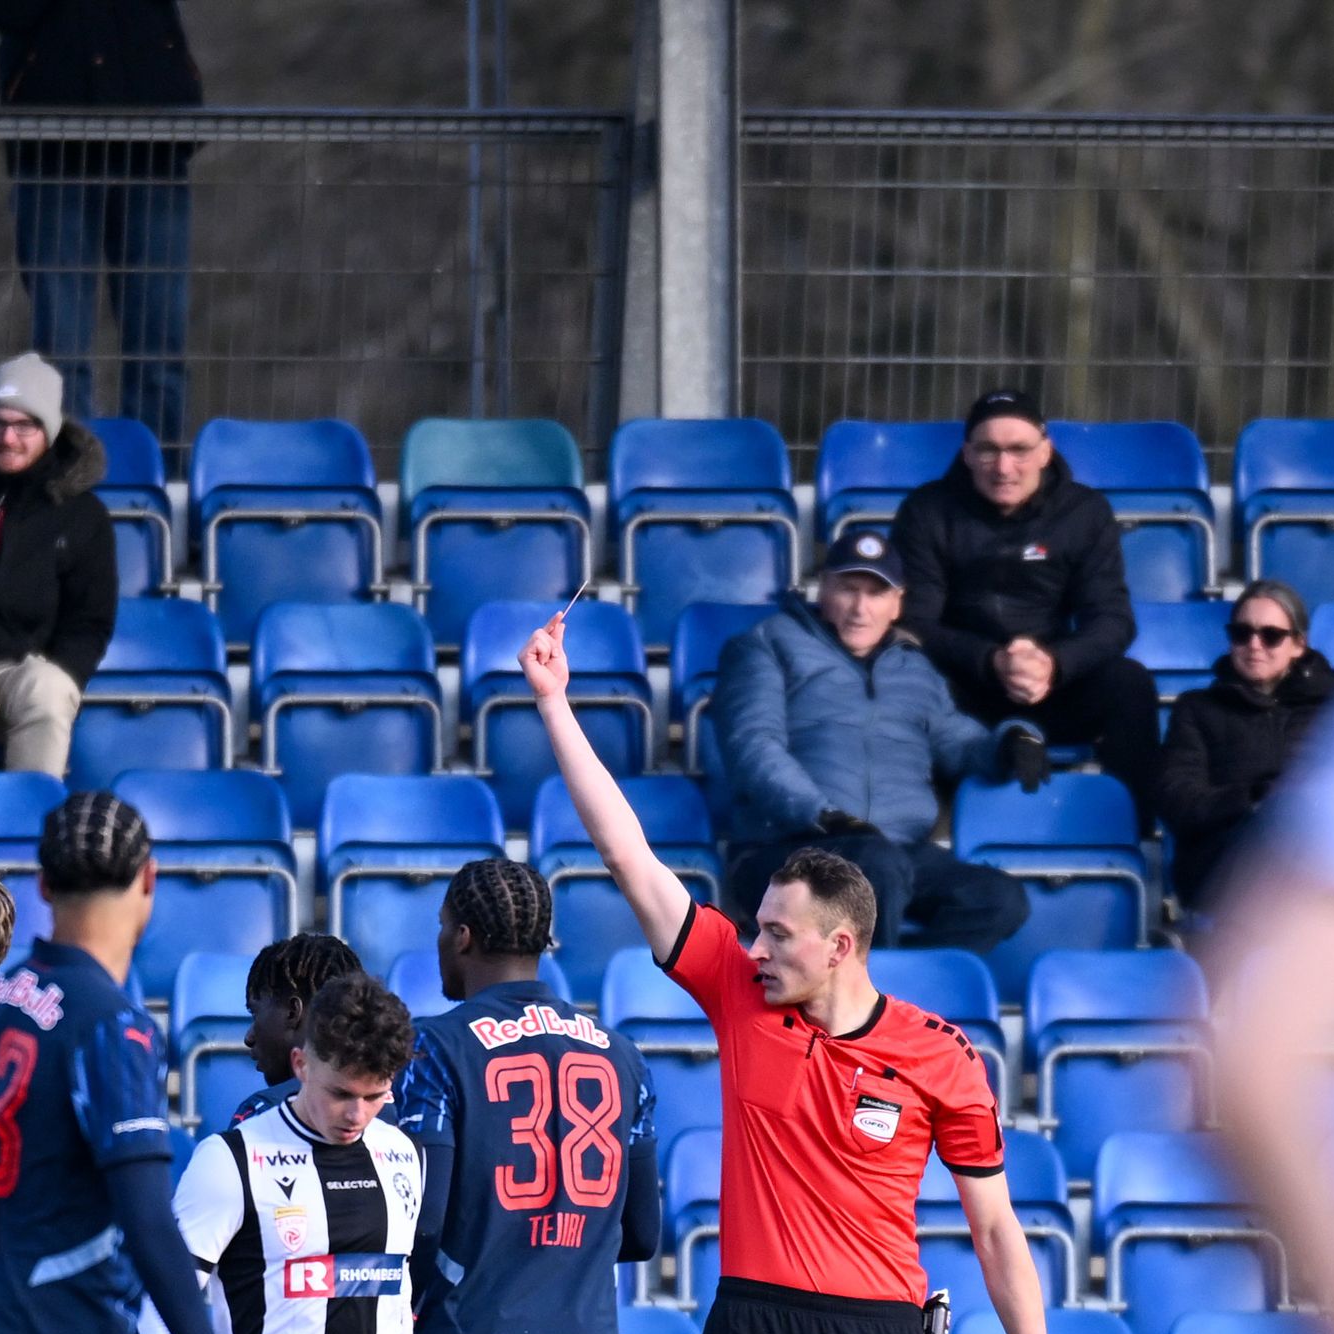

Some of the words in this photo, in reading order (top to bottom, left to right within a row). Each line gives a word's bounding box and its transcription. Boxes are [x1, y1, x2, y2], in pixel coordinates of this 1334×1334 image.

[485, 1051, 622, 1211] 38
[265, 1150, 308, 1167] vkw
[384, 1149, 414, 1164] vkw
[326, 1179, 378, 1191] SELECTOR
[529, 1212, 586, 1249] TEJIRI
